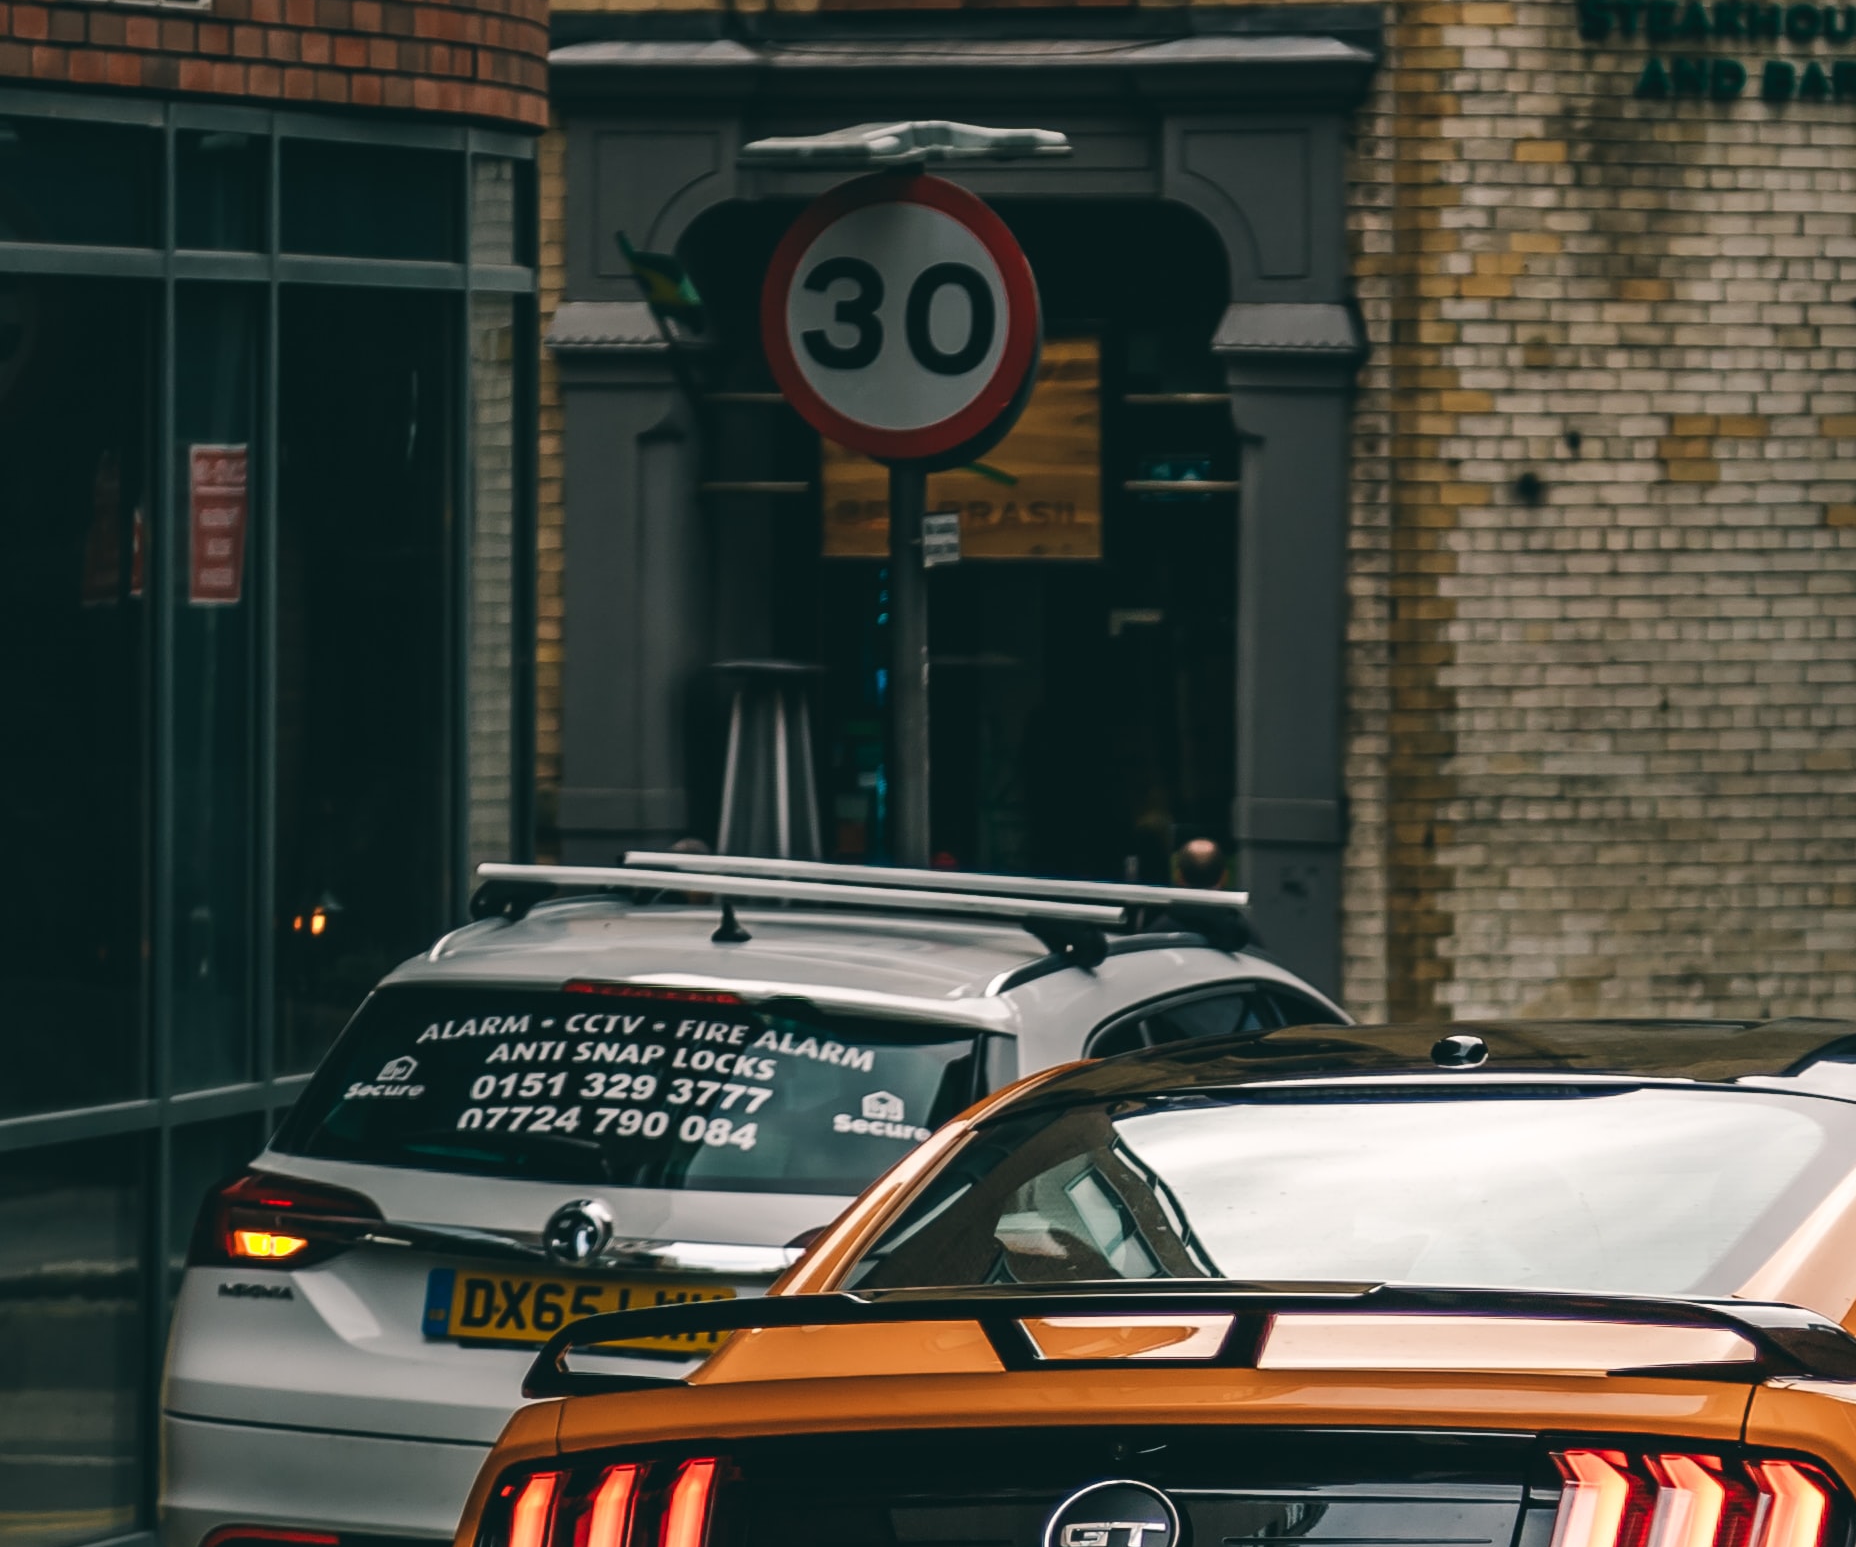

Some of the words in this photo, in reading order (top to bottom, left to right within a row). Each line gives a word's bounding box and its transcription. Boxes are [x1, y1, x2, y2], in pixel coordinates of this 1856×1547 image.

[1635, 57, 1747, 99] AND
[802, 257, 996, 376] 30
[416, 1014, 532, 1044] ALARM
[565, 1014, 645, 1035] CCTV
[675, 1020, 749, 1045] FIRE
[752, 1030, 875, 1072] ALARM
[485, 1041, 567, 1064] ANTI
[572, 1041, 666, 1065] SNAP
[672, 1048, 777, 1081] LOCKS
[343, 1081, 426, 1101] Secure
[470, 1071, 569, 1100] 0151
[579, 1072, 657, 1100] 329
[667, 1078, 773, 1114] 3777
[456, 1105, 581, 1134] 07724
[593, 1108, 669, 1139] 790
[680, 1115, 758, 1151] 084
[833, 1112, 932, 1142] Secure
[460, 1278, 604, 1332] DX65
[1060, 1522, 1167, 1547] GT
